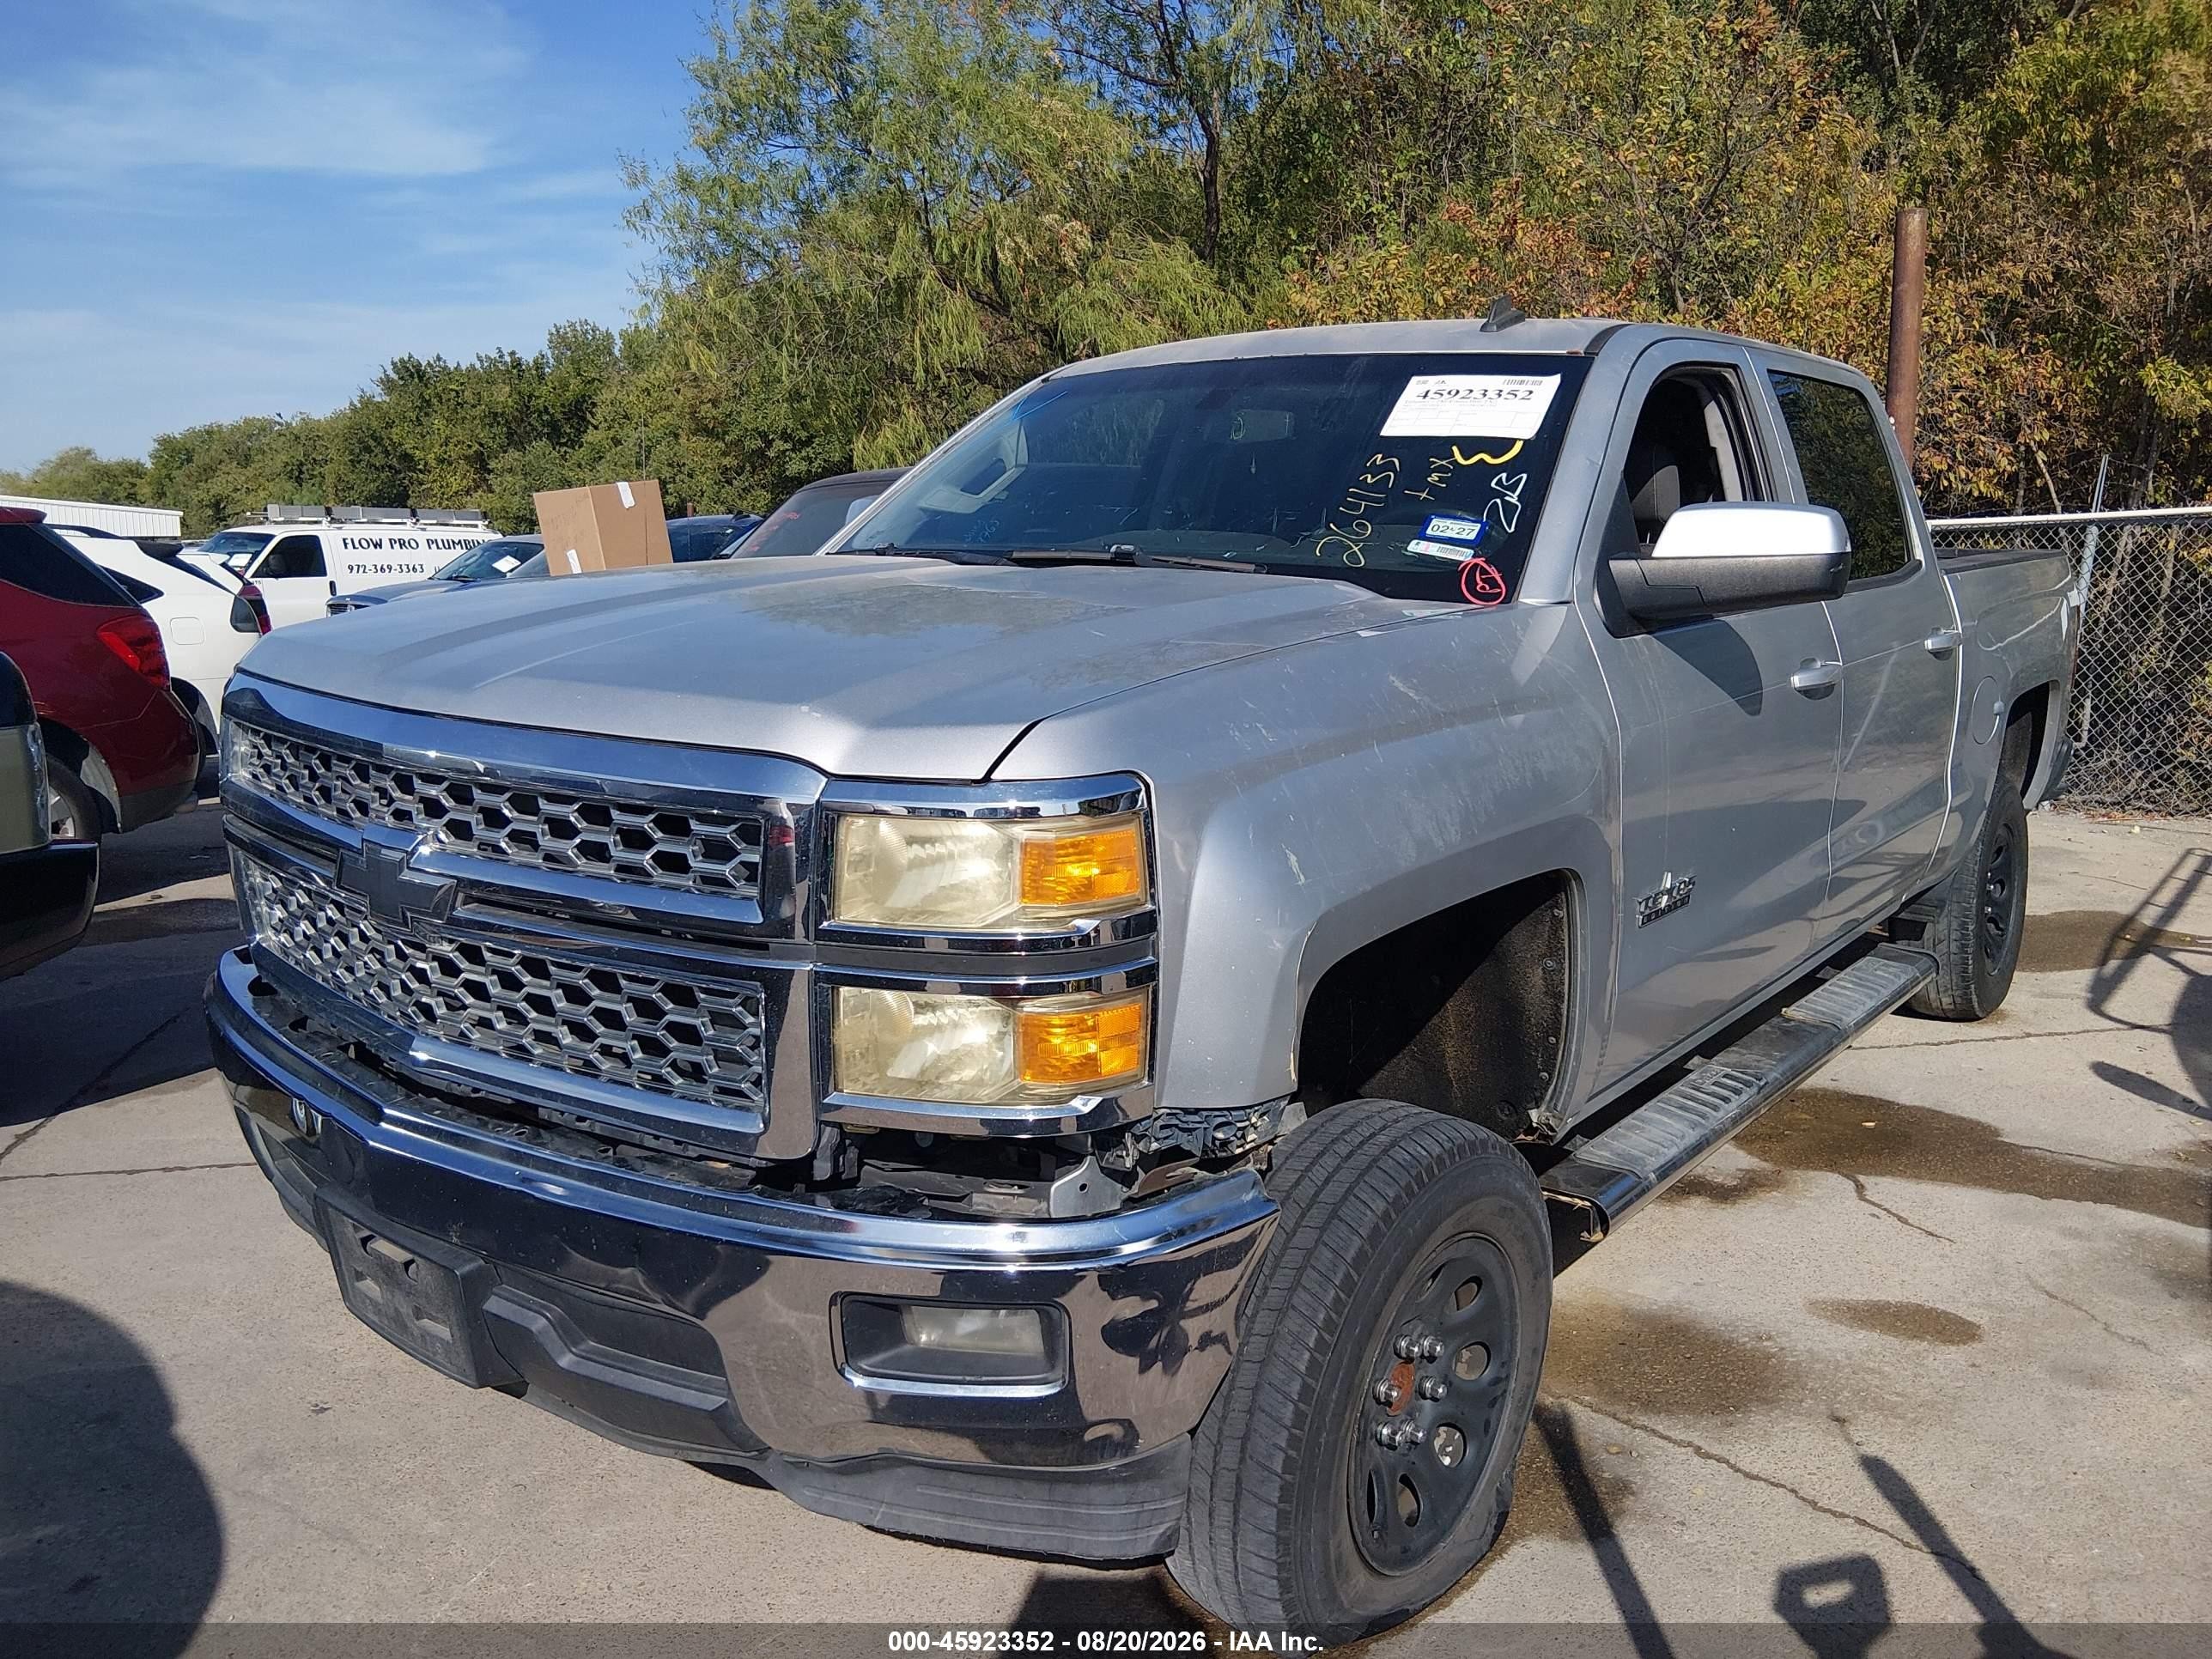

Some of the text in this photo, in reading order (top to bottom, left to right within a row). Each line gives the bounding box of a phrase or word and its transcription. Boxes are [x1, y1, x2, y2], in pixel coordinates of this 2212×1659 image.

[1416, 389, 1534, 401] 45923352
[1316, 453, 1401, 568] 264133
[1431, 524, 1476, 537] 02 27
[342, 537, 383, 550] FLOW
[388, 538, 420, 550] PRO
[347, 563, 425, 574] 972-369-3363
